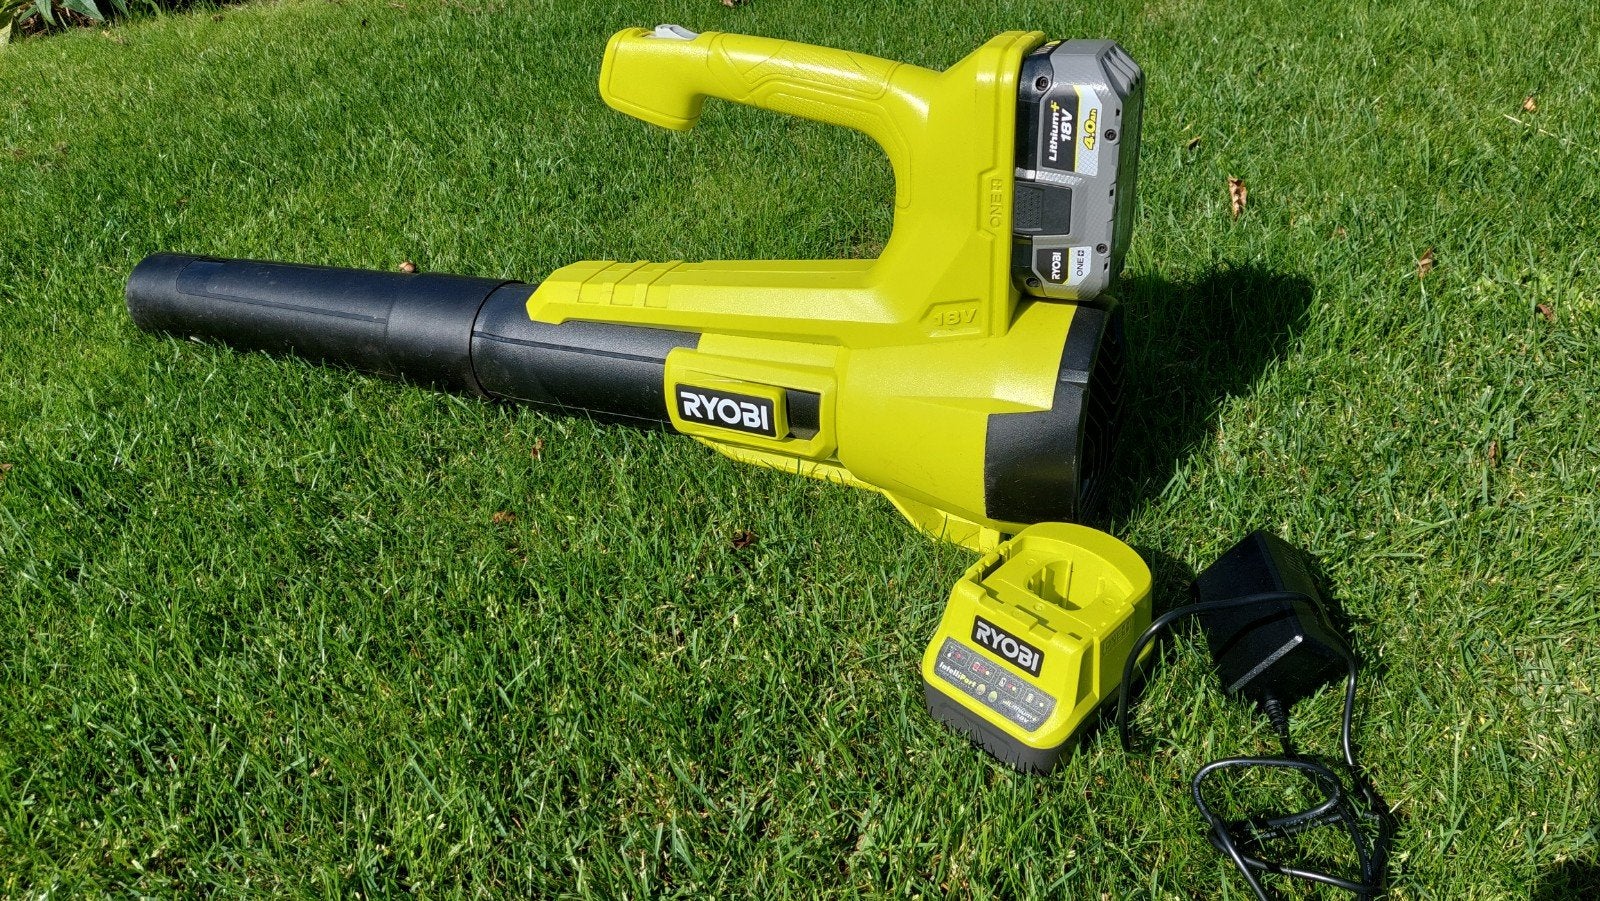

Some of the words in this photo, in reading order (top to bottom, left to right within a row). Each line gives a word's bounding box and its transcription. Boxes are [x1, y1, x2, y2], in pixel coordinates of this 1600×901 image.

[1048, 100, 1060, 162] Lithium+
[1061, 108, 1073, 142] 18V
[1083, 108, 1097, 151] 4.0Ah
[1051, 251, 1062, 280] RYOBI
[935, 308, 977, 327] 18V
[680, 391, 769, 431] RYOBI
[975, 620, 1040, 672] RYOBI
[939, 661, 977, 688] IntelliPort
